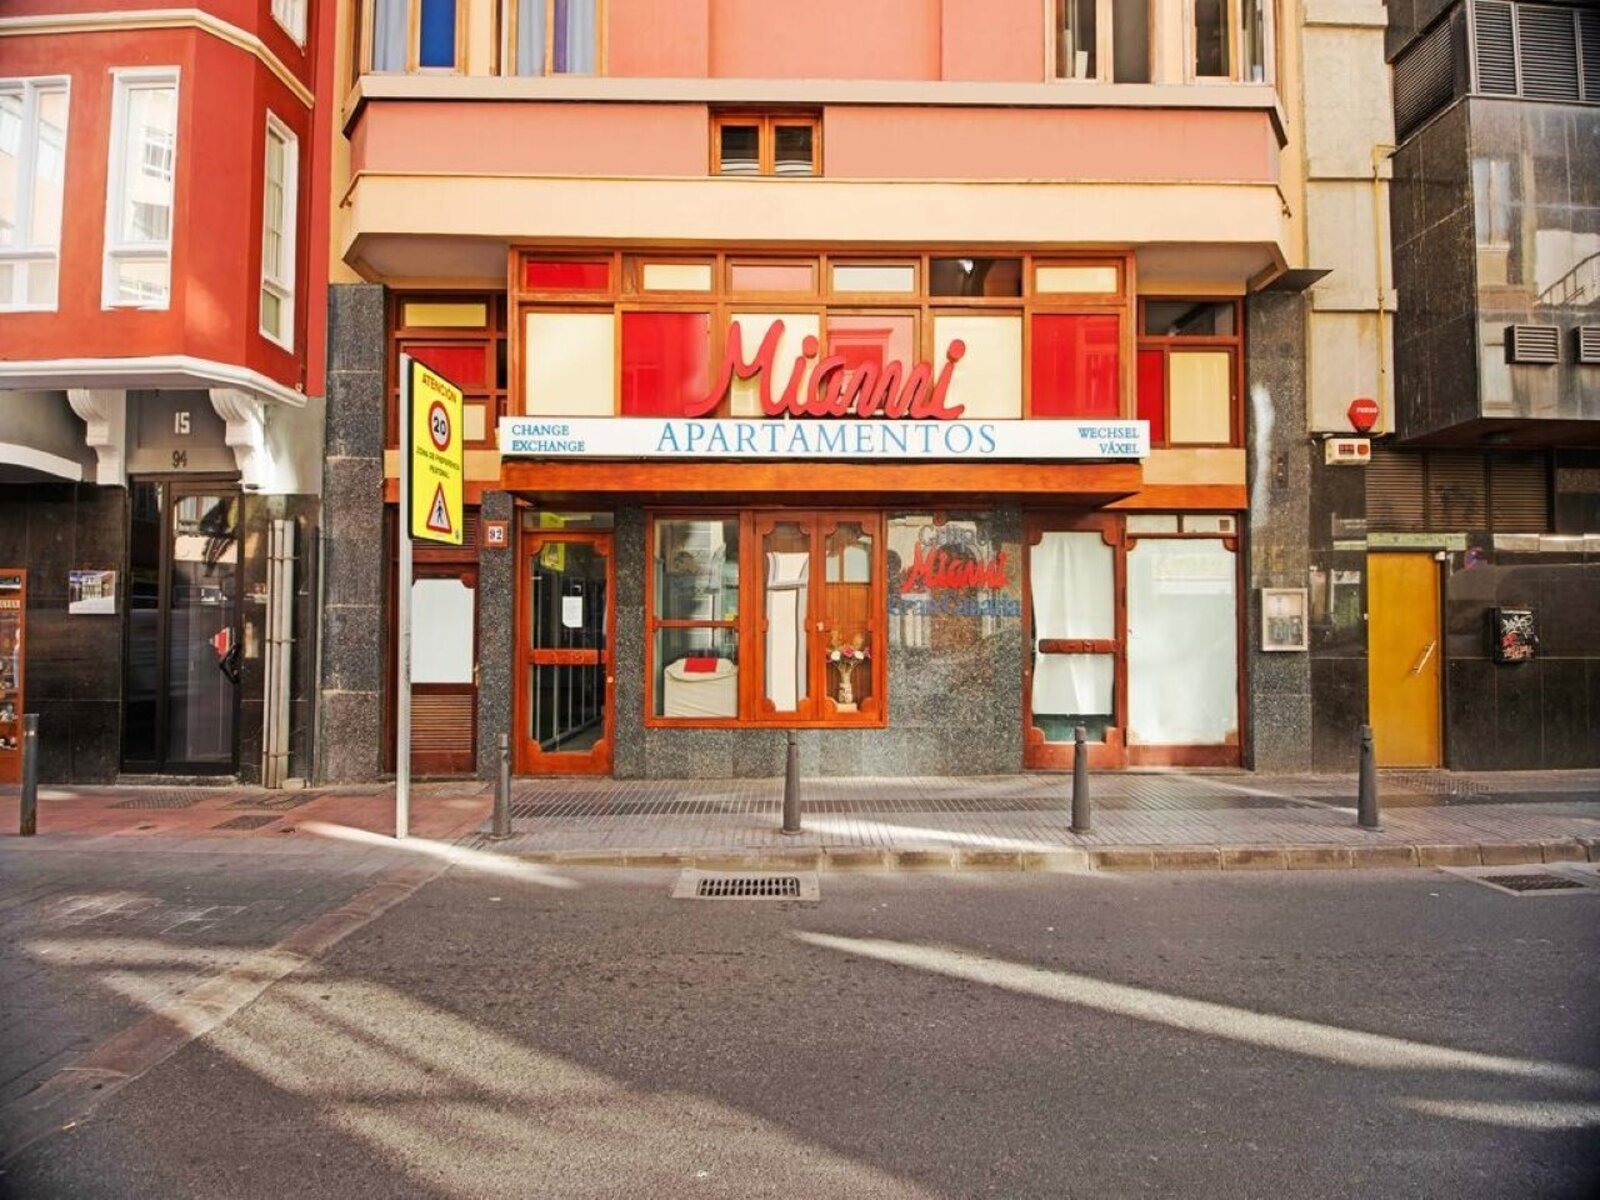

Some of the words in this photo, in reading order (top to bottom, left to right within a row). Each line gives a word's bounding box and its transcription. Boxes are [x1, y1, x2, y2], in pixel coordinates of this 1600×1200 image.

[684, 319, 966, 420] Miami
[174, 411, 191, 434] 15
[433, 416, 447, 436] 20
[511, 424, 570, 436] CHANGE
[656, 422, 997, 454] APARTAMENTOS
[1077, 427, 1140, 439] WECHSEL
[511, 440, 585, 452] EXCHANGE
[172, 449, 188, 469] 94
[489, 528, 502, 540] 92
[900, 540, 1009, 594] Miami
